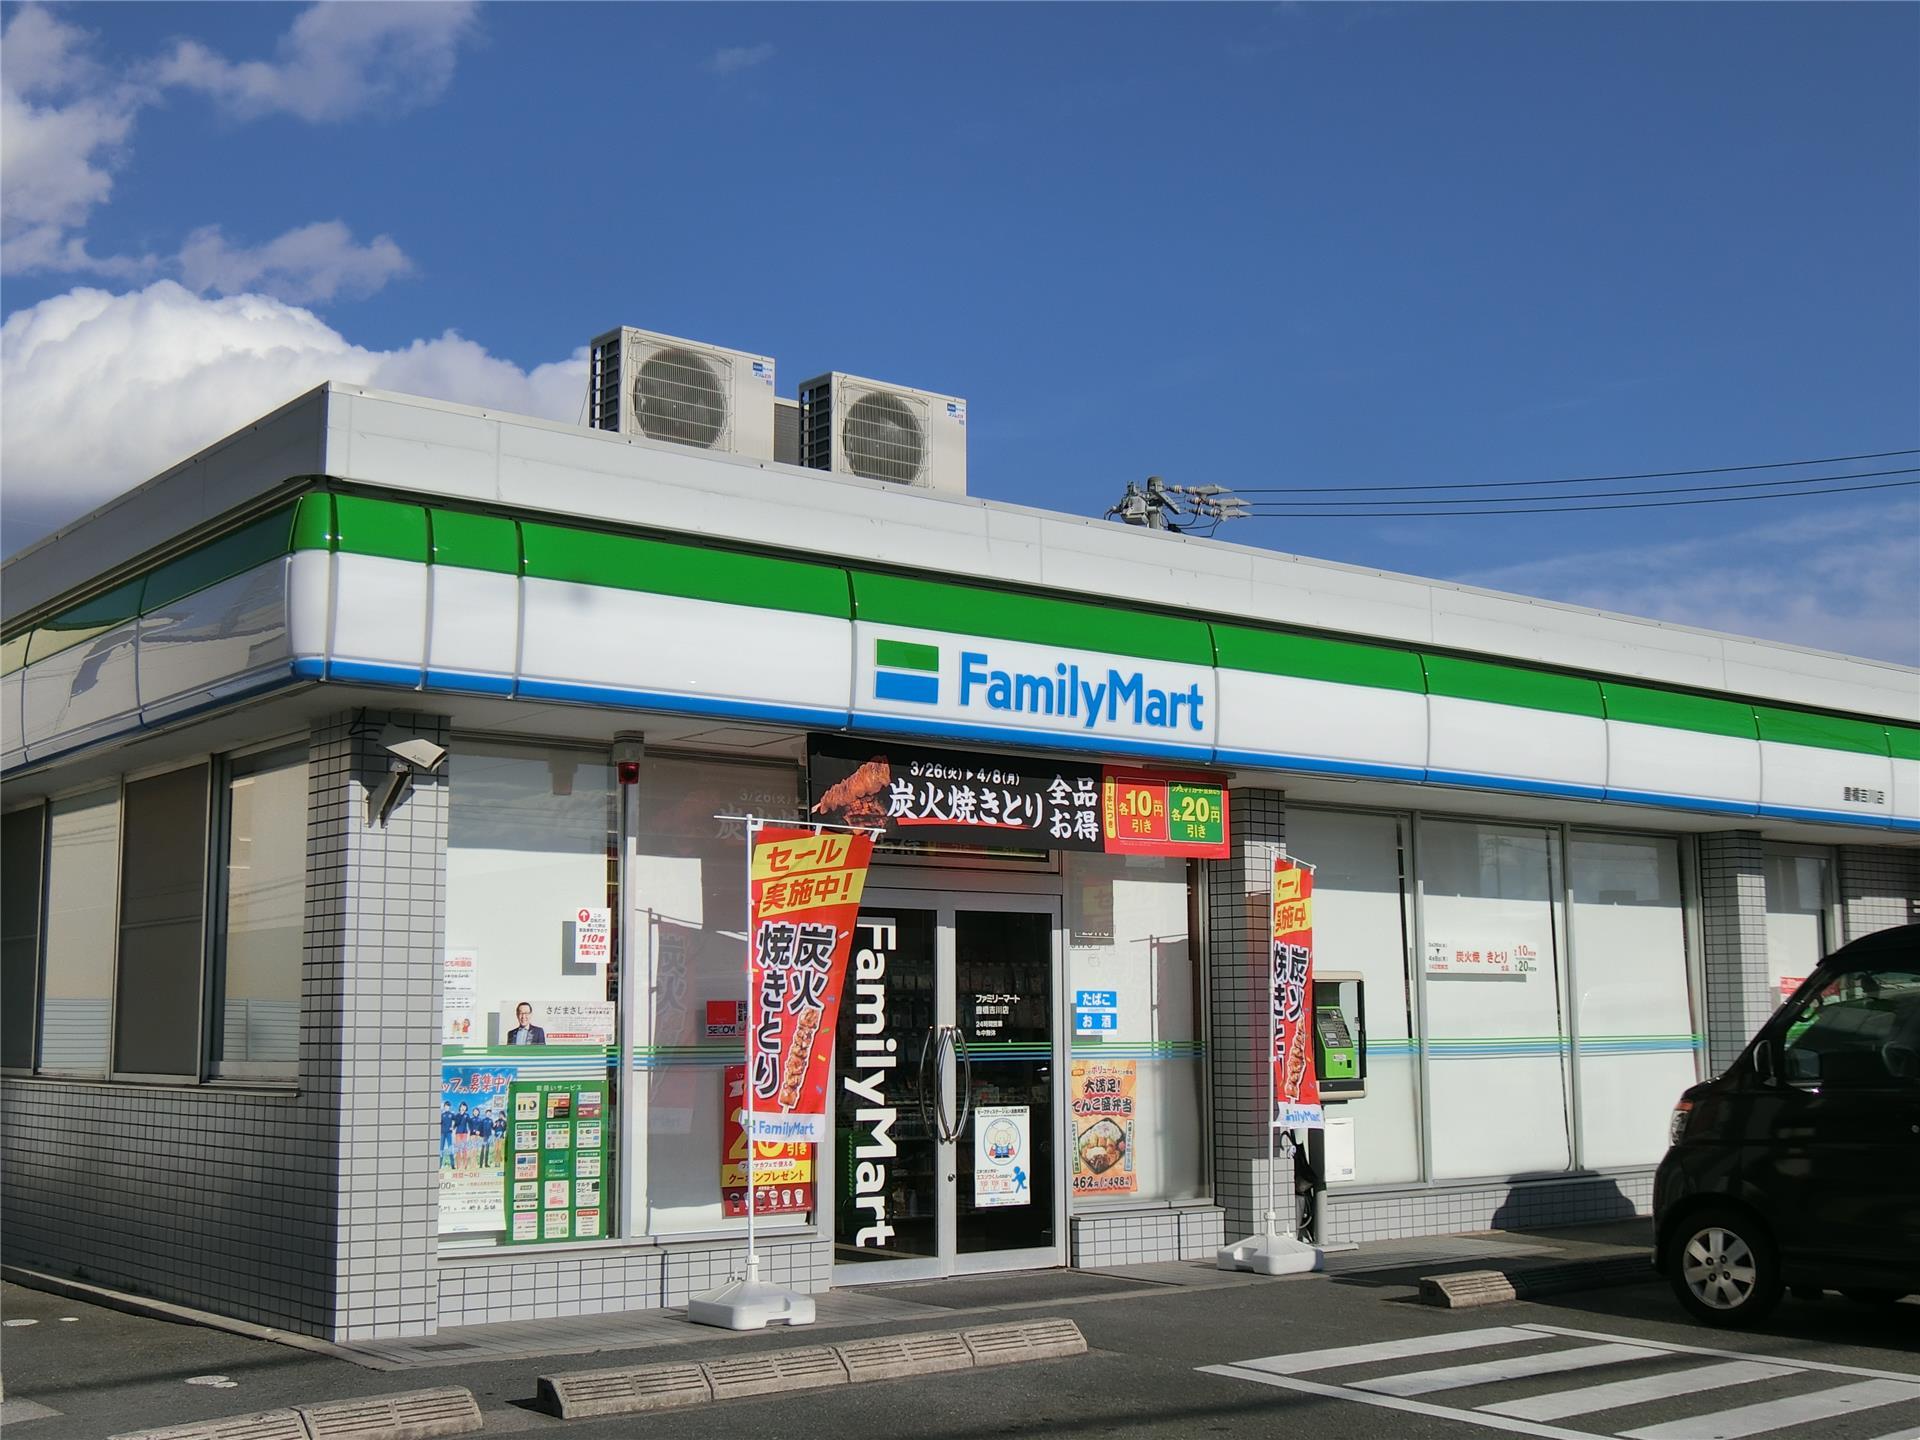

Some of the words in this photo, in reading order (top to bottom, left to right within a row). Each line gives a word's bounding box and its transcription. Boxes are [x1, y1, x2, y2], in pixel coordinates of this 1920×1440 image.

[959, 650, 1204, 731] FamilyMart
[910, 760, 963, 781] 3/26(火)
[976, 767, 1020, 787] 4/8(月)
[886, 777, 1043, 829] 炭火焼きとり
[1046, 774, 1099, 808] 全品
[1049, 808, 1100, 843] お得
[766, 839, 843, 873] セール
[762, 872, 853, 913] 実施中!
[546, 1005, 583, 1016] さだまさし
[754, 923, 794, 1096] 焼きとり
[976, 994, 1021, 1004] ファミリーマート
[1082, 992, 1111, 1006] たばこ
[707, 1025, 736, 1034] SECOM
[845, 917, 897, 1248] FamilyMart
[1085, 1079, 1121, 1093] 大満足!
[759, 1120, 814, 1138] FamilyMart
